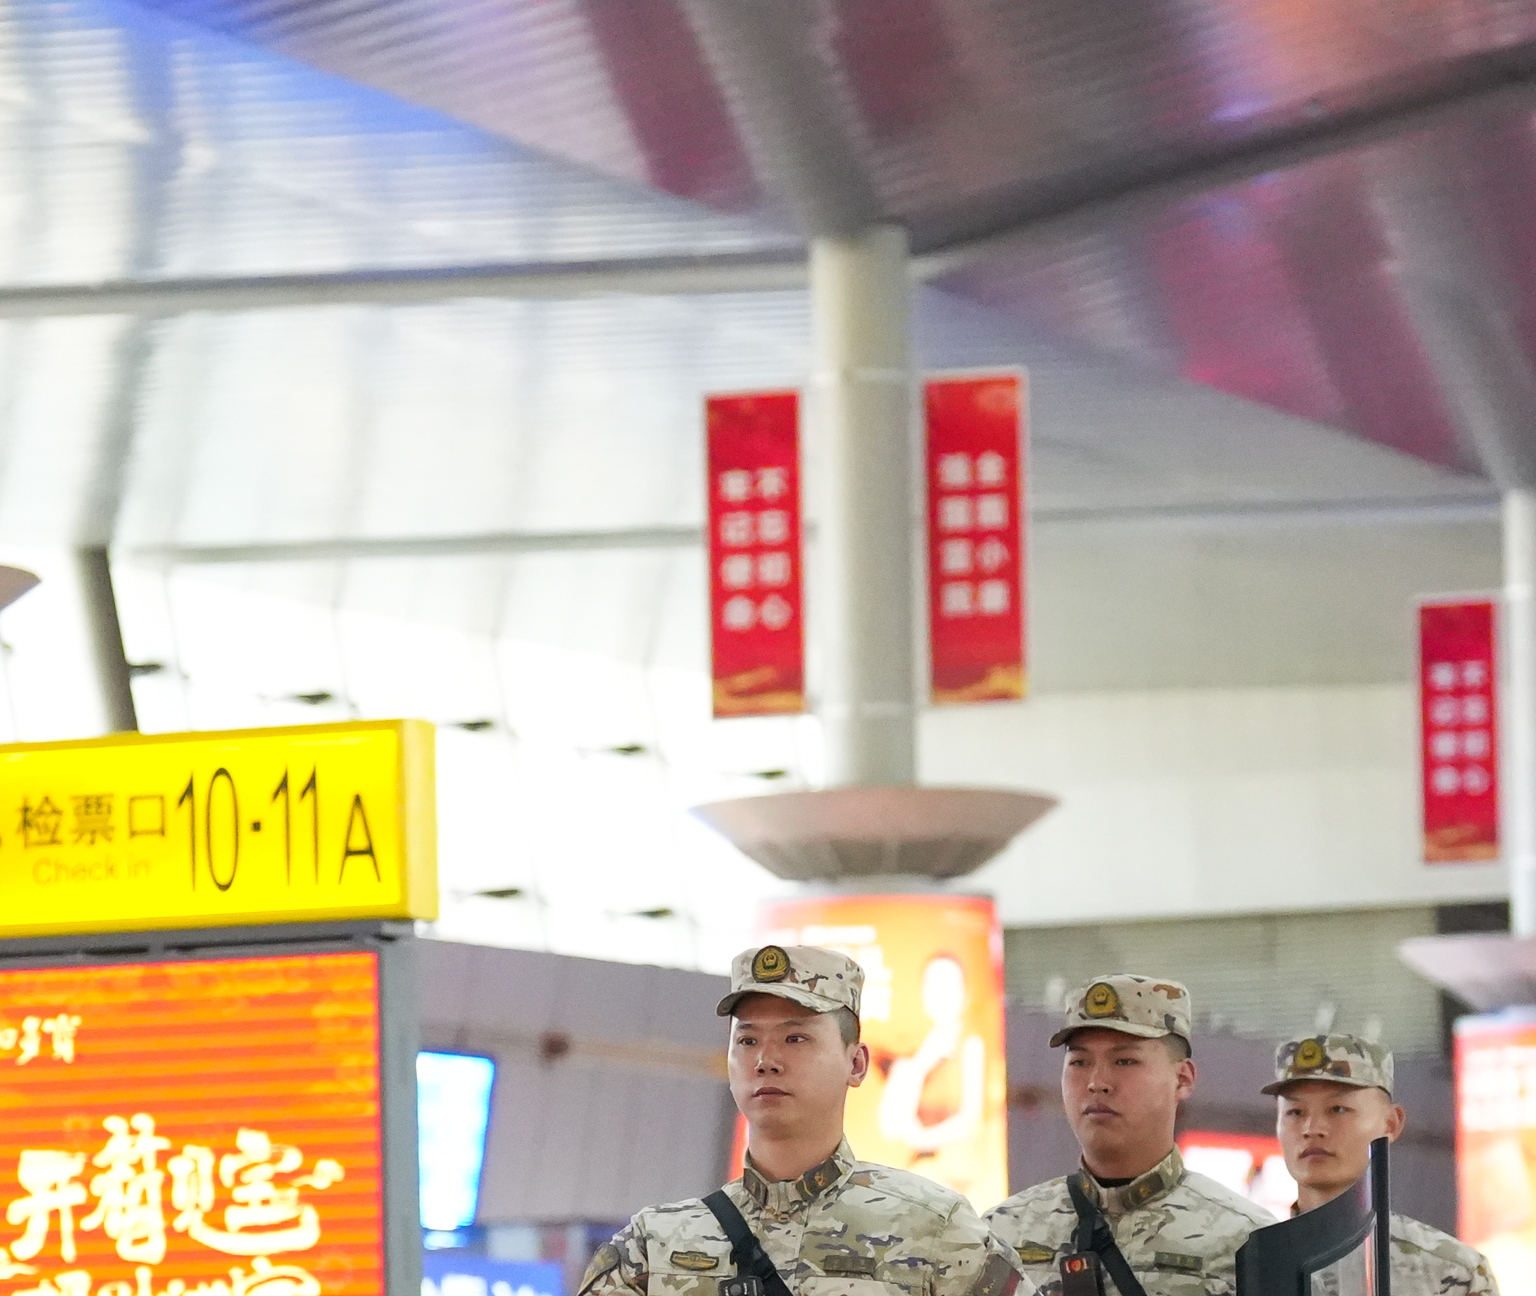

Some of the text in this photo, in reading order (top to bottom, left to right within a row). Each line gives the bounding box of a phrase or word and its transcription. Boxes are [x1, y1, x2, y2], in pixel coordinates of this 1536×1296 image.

[15, 793, 166, 850] 检票口
[31, 855, 152, 887] Check in
